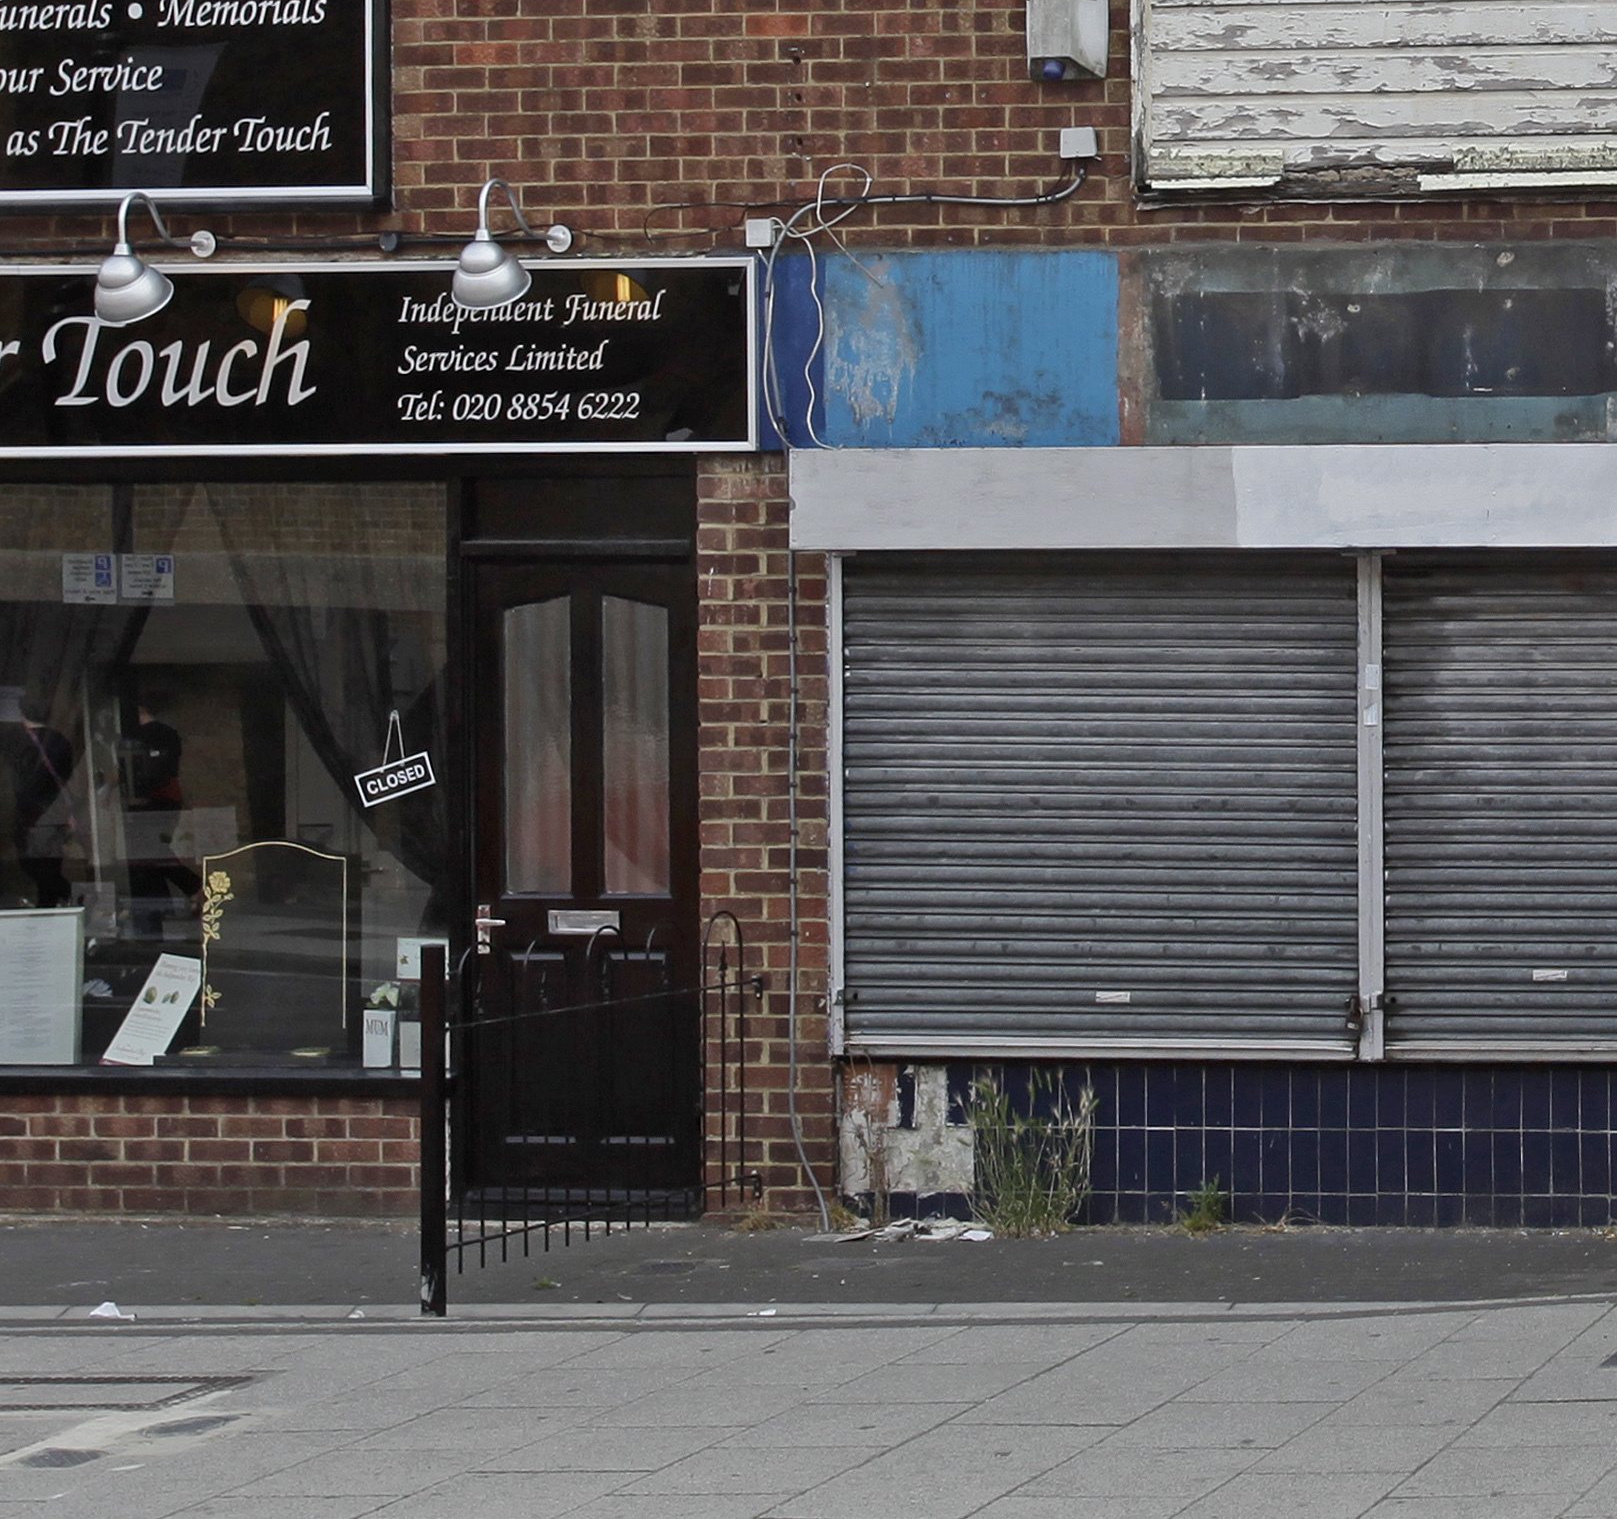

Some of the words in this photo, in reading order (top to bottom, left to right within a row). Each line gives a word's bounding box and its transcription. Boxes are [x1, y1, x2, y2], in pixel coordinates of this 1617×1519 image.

[50, 56, 163, 96] Service
[6, 129, 40, 156] as
[48, 115, 109, 156] The
[117, 114, 227, 155] Tender
[233, 111, 332, 155] Touch
[563, 289, 666, 328] Funeral
[42, 299, 317, 407] Touch
[398, 344, 498, 375] Services
[505, 340, 609, 372] Limited
[397, 390, 445, 421] Tel:
[452, 393, 501, 421] 020
[507, 393, 570, 421] 8854
[577, 392, 640, 420] 6222
[366, 764, 425, 795] CLOSED
[365, 1019, 388, 1036] MUM
